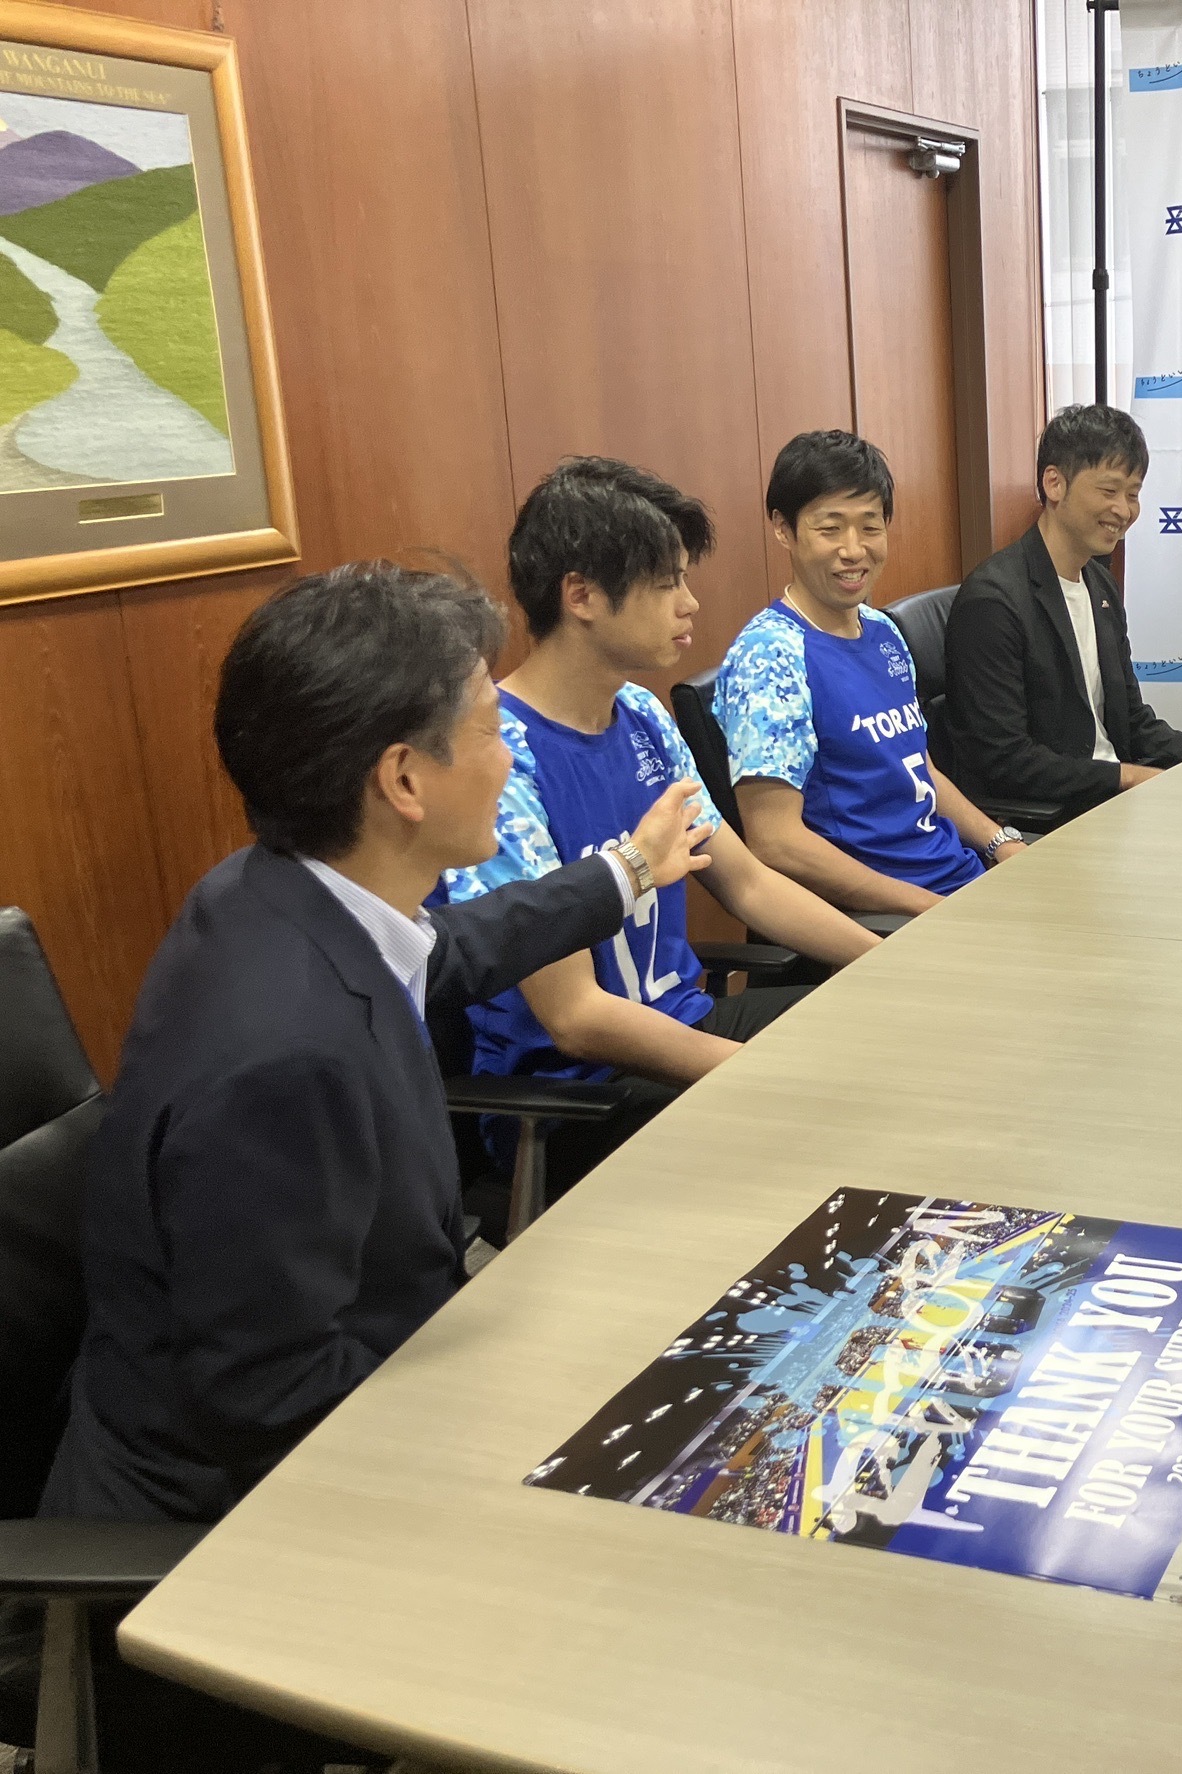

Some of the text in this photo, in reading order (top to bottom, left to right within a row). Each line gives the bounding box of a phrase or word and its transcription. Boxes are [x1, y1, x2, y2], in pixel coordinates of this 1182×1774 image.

[902, 752, 936, 833] 5
[945, 1341, 1142, 1508] THANK
[1064, 1459, 1154, 1528] FOR
